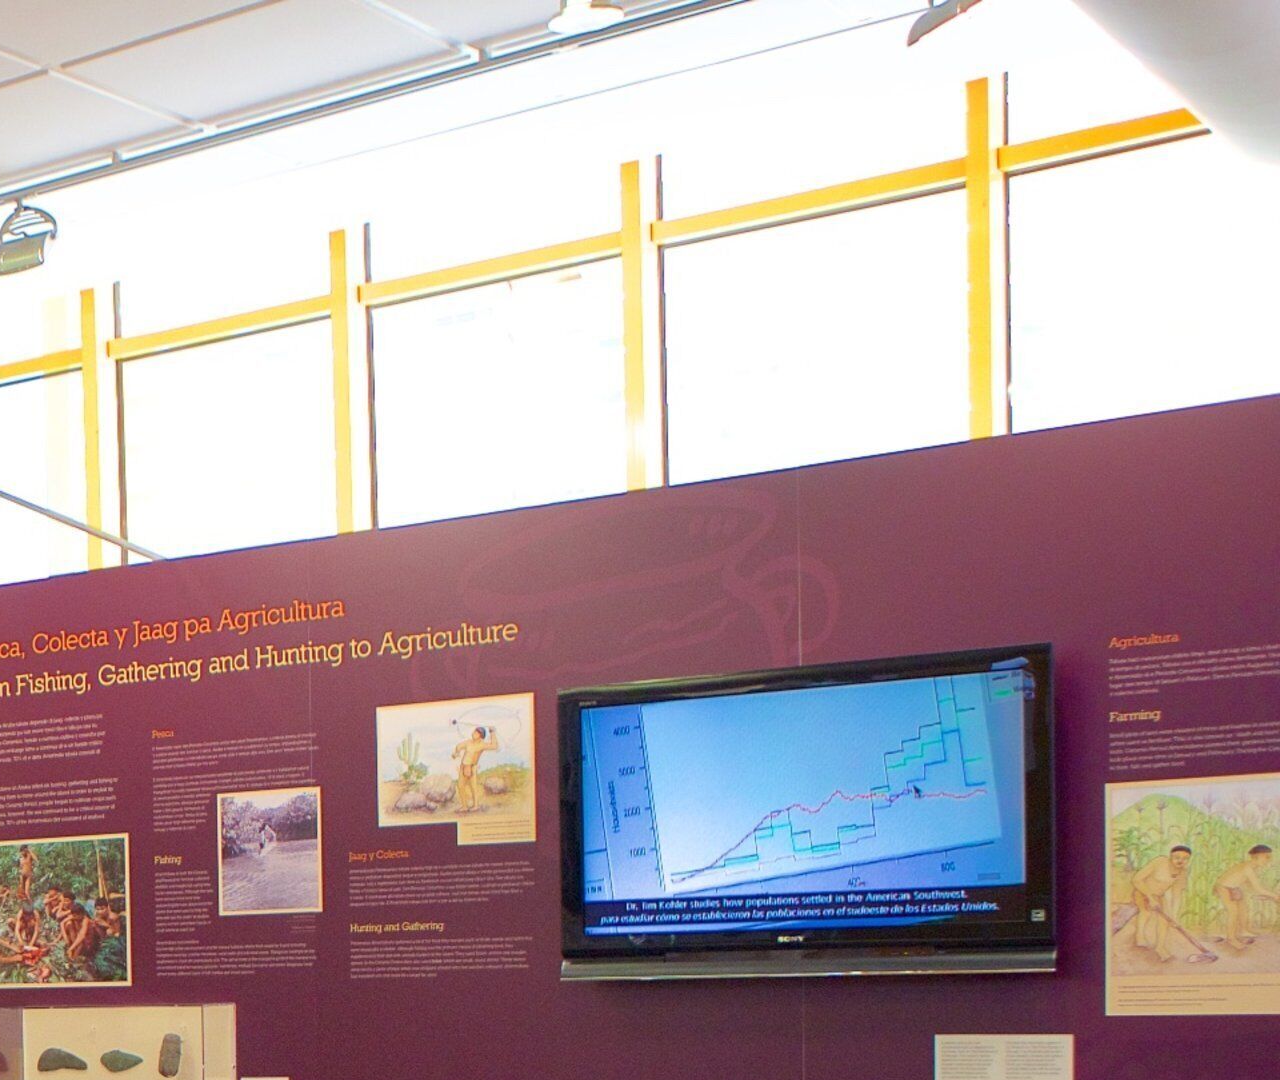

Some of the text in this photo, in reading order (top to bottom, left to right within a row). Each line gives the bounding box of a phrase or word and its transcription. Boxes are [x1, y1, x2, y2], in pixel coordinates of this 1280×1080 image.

[32, 629, 109, 654] Colecta
[114, 627, 128, 650] y
[133, 620, 178, 648] Jaag
[184, 616, 211, 642] pa
[217, 599, 345, 635] Agricultura
[1109, 633, 1180, 649] Agricultura
[15, 670, 91, 695] Fishing,
[98, 656, 203, 686] Gathering
[208, 648, 250, 674] and
[255, 641, 344, 669] Hunting
[349, 638, 372, 659] to
[377, 622, 519, 660] Agriculture
[1109, 710, 1162, 723] Farming
[689, 899, 720, 909] studies
[723, 898, 743, 907] how
[745, 894, 800, 908] populations
[801, 893, 833, 904] settled
[835, 893, 845, 902] in
[847, 892, 863, 902] the
[865, 889, 910, 900] American
[350, 923, 382, 934] Hunting
[383, 923, 400, 932] and
